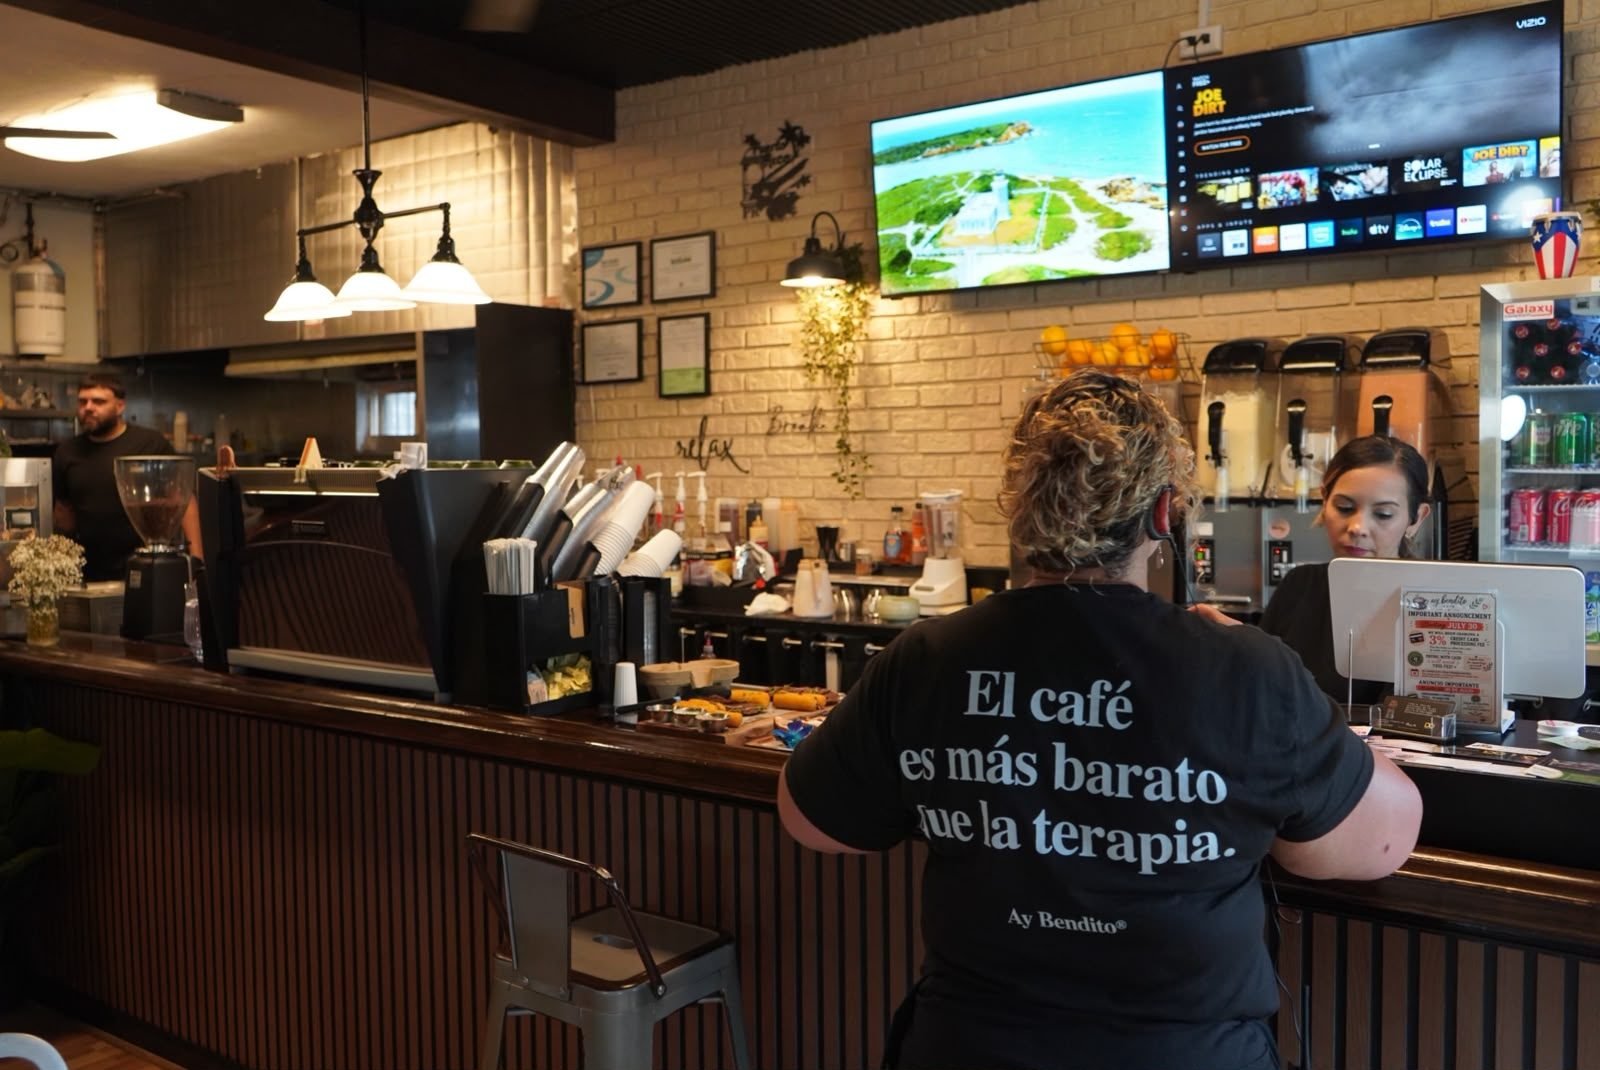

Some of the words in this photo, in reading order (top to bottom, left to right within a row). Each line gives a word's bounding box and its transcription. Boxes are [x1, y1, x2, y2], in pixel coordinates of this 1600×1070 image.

[1516, 16, 1546, 29] VIZIO
[1193, 88, 1222, 104] JOE
[1193, 101, 1227, 117] DIRT
[1473, 147, 1497, 162] JOE
[1498, 144, 1530, 159] DIRT
[1404, 158, 1442, 172] SOLAR
[1404, 168, 1448, 182] ECLIPSE
[1504, 304, 1553, 315] Galaxy
[676, 415, 750, 474] relax
[1444, 612, 1491, 620] ANNOUNCEMENT
[1429, 635, 1446, 645] 3%
[963, 670, 1016, 718] El
[1030, 680, 1134, 730] café
[900, 747, 936, 781] es
[945, 734, 1038, 786] más
[1053, 741, 1228, 804] barato
[979, 800, 1021, 850] la
[1032, 808, 1236, 875] terapia.
[1008, 908, 1033, 929] Ay
